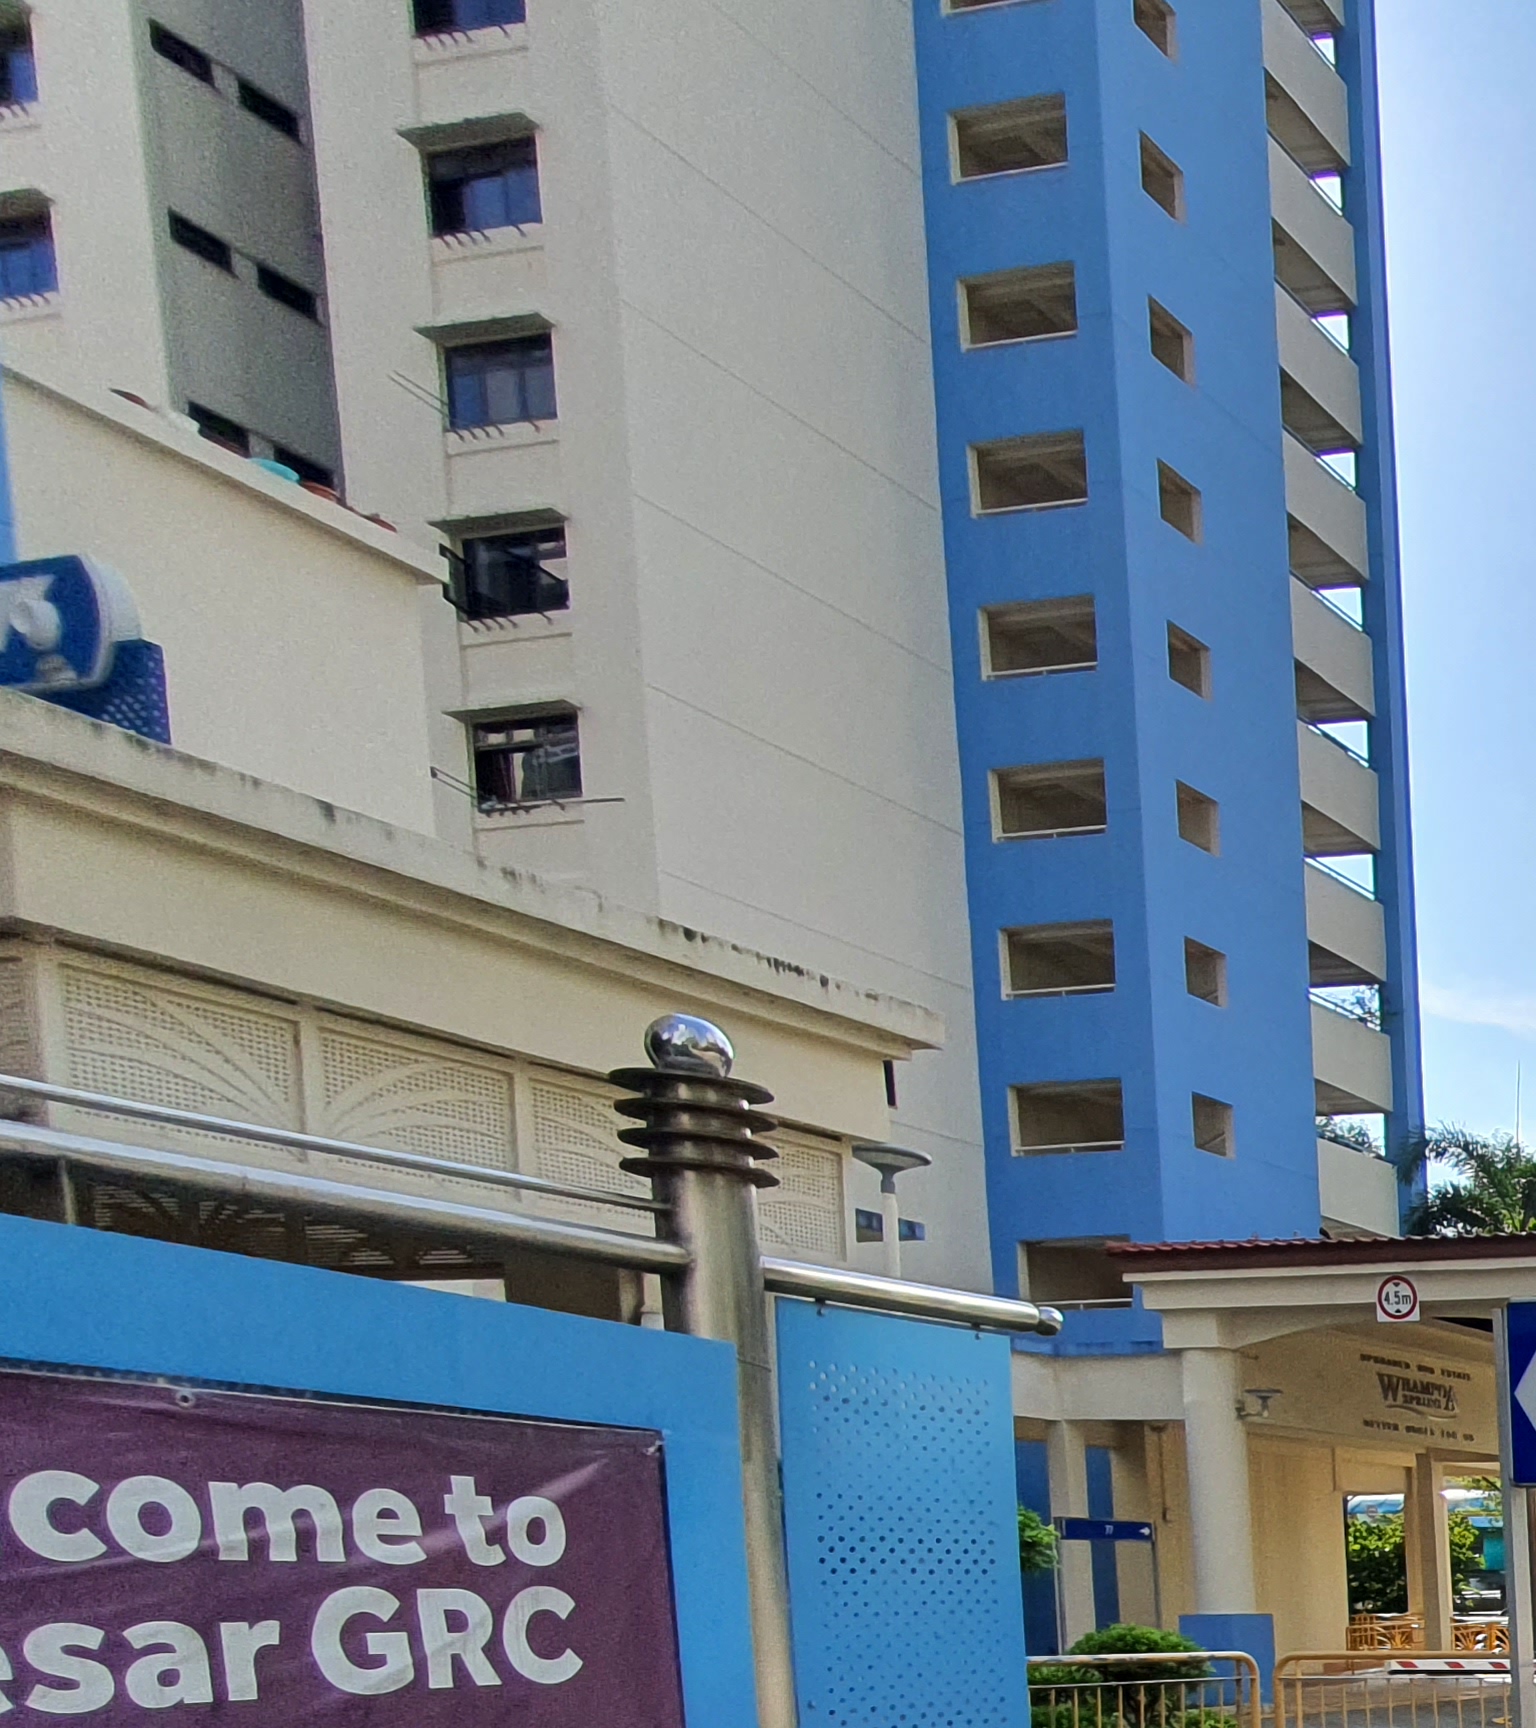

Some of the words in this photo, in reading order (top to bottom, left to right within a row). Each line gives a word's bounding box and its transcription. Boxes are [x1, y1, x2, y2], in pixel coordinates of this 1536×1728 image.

[1384, 1291, 1411, 1305] 4.5m
[444, 1475, 567, 1567] to
[0, 1619, 280, 1715] sar
[311, 1586, 583, 1695] GRC
